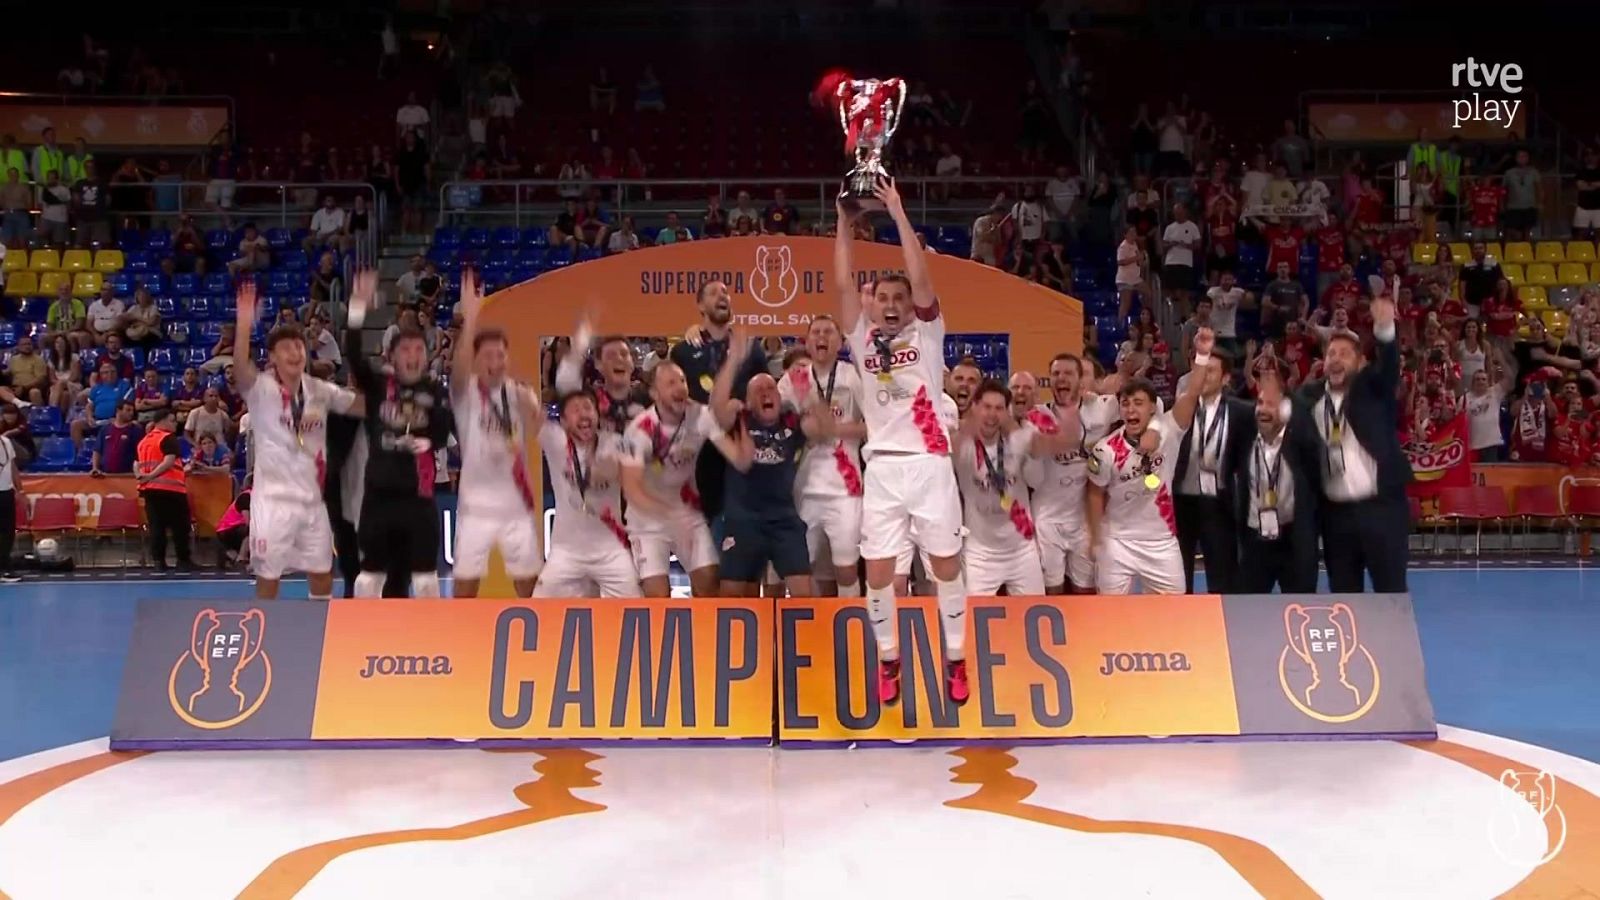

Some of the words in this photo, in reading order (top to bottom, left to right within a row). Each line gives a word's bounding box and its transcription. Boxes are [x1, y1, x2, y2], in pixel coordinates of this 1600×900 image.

[803, 271, 825, 294] DE
[214, 634, 241, 646] RF
[1309, 629, 1336, 640] RF
[1311, 641, 1338, 652] EF
[212, 647, 239, 659] EF
[488, 604, 1074, 730] CAMPEONES
